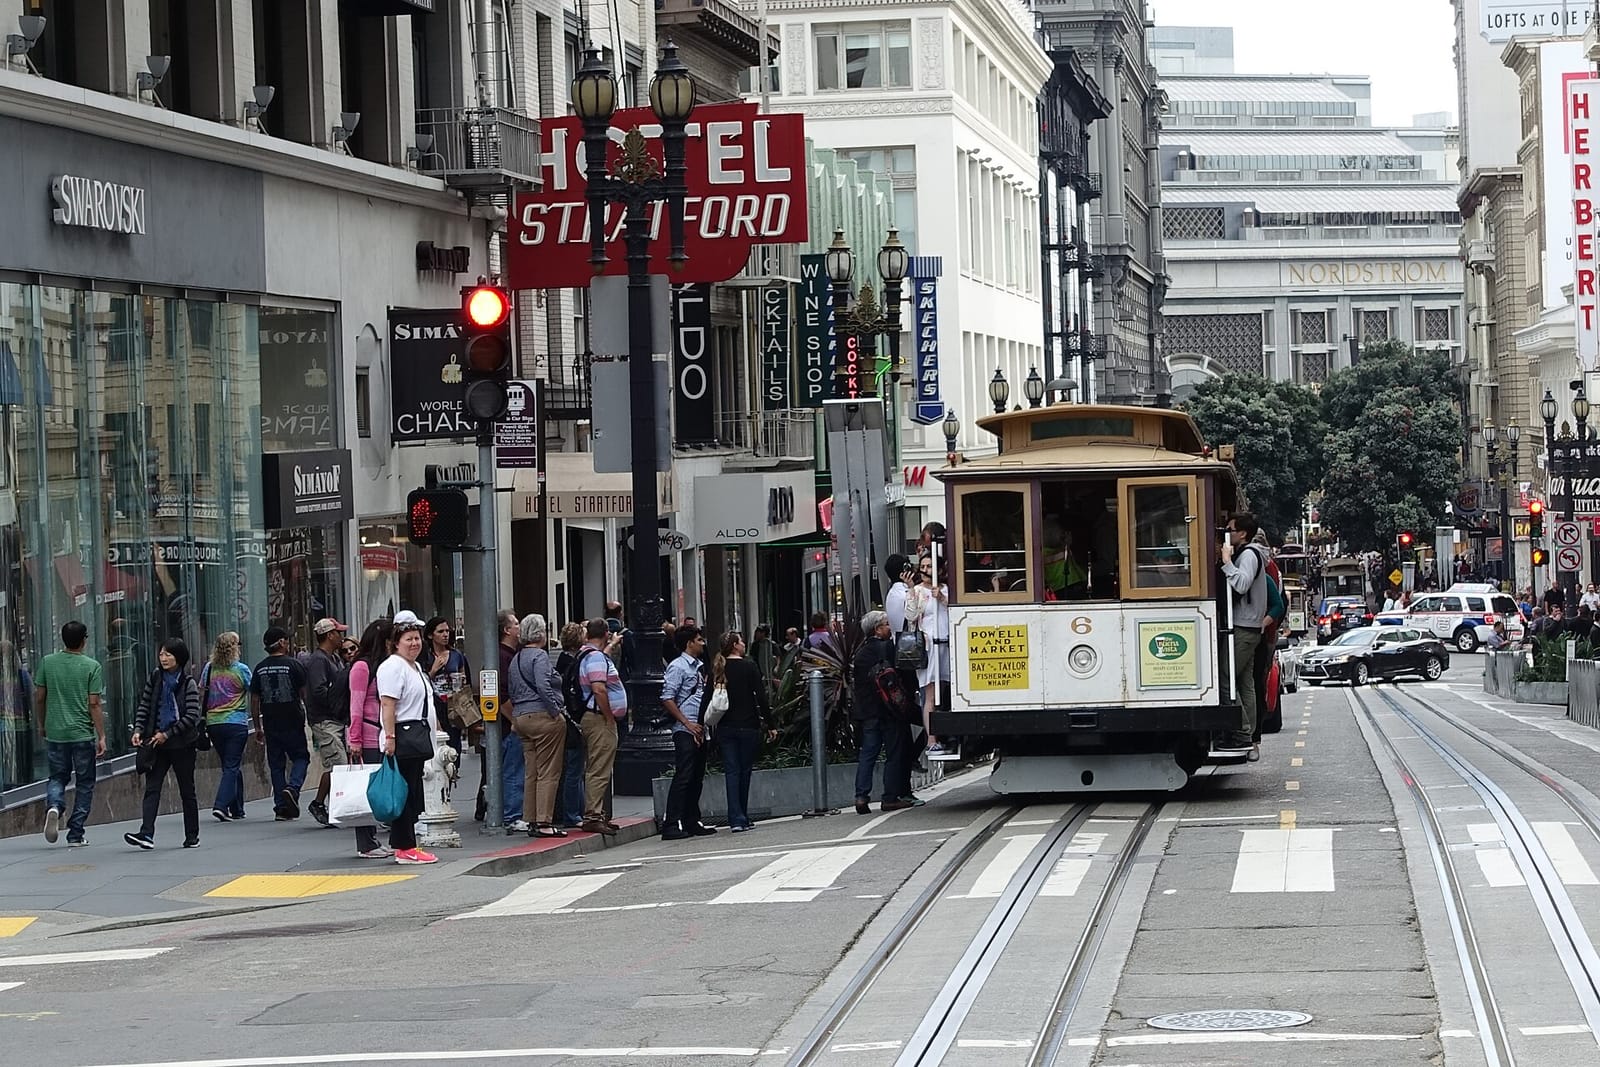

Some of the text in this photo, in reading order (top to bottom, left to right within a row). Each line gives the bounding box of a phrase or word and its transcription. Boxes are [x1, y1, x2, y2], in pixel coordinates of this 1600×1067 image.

[1488, 13, 1526, 28] LOFTS
[1532, 15, 1544, 26] AT
[59, 174, 146, 235] SWAROVSKI
[1572, 93, 1595, 331] HERBERT
[1288, 261, 1446, 284] NORDSTROM
[394, 323, 462, 340] SIMĀ
[802, 263, 822, 398] WINE SHOP
[919, 281, 938, 396] SKECHERS
[397, 412, 477, 434] CHAR
[526, 496, 632, 513] HOEL STRATFOR
[716, 528, 760, 538] ALDO
[1070, 617, 1092, 634] 6
[971, 629, 1025, 640] POWELL
[985, 638, 1011, 646] AND
[970, 644, 1025, 654] MARKET
[971, 662, 986, 672] BAY
[998, 661, 1026, 671] TAYLOR
[976, 672, 1022, 680] FISHERMANS
[987, 679, 1011, 687] WHARF
